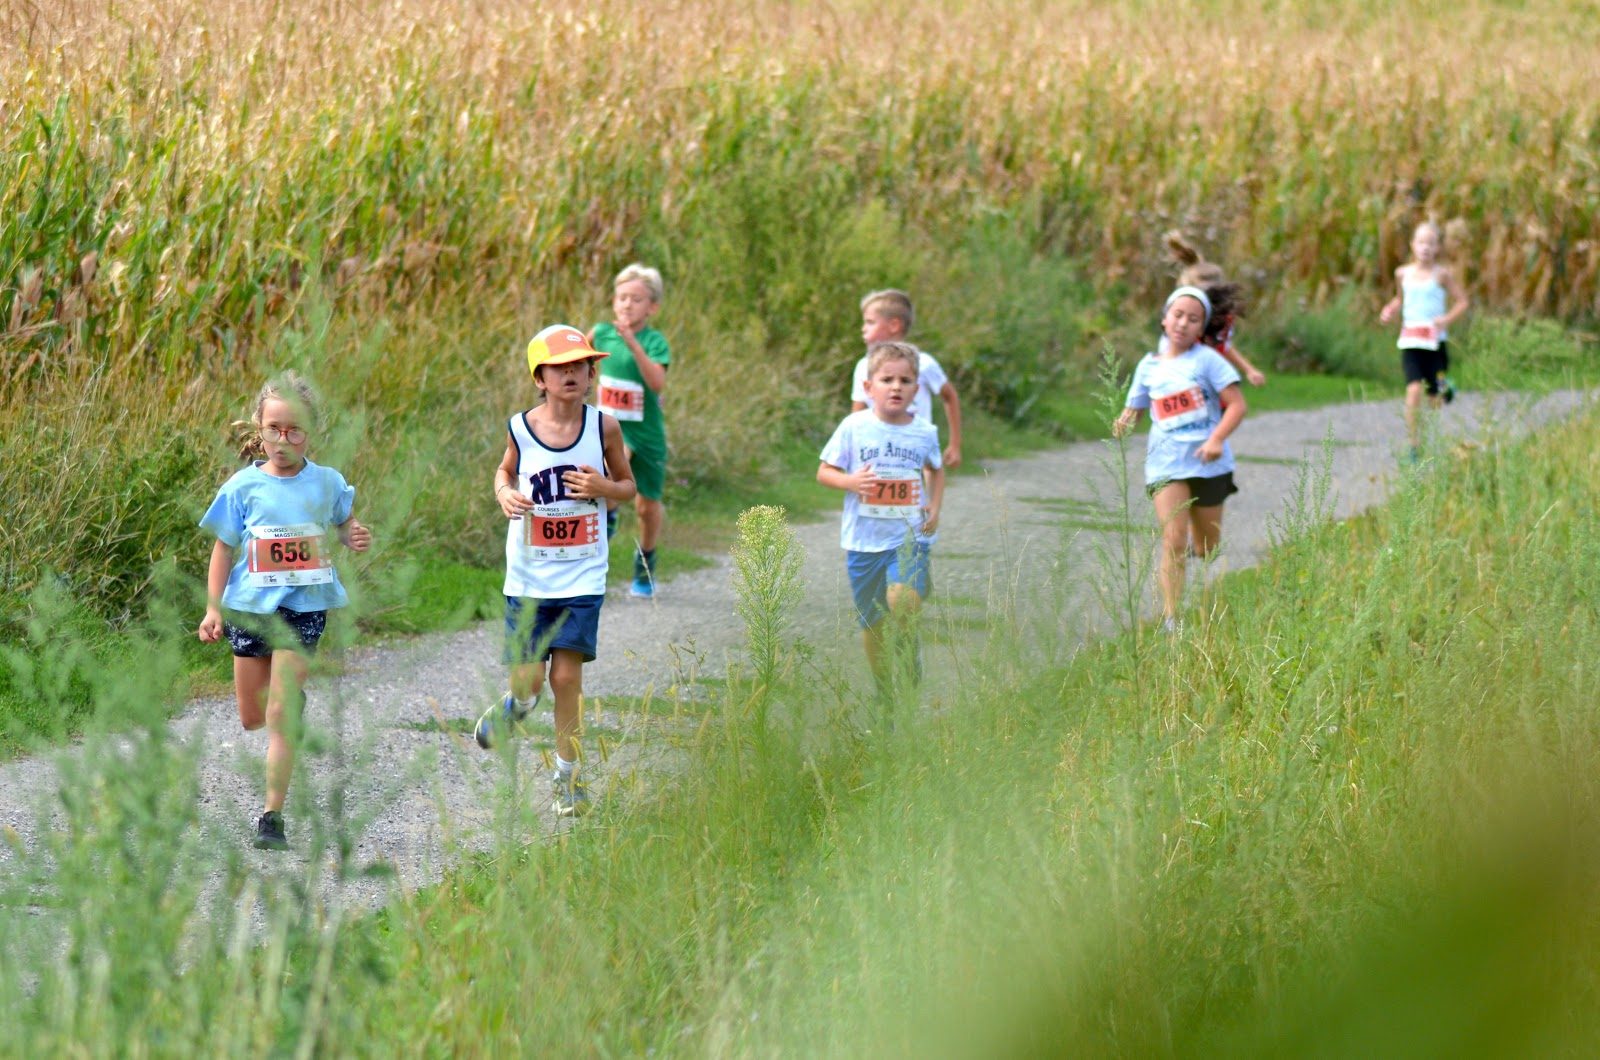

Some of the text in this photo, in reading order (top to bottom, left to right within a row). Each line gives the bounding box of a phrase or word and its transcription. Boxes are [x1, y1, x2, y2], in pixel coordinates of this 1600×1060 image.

[607, 389, 629, 405] 714
[1163, 393, 1189, 413] 676
[860, 446, 879, 462] Los
[876, 483, 907, 499] 718
[542, 520, 580, 540] 687
[270, 541, 311, 563] 658
